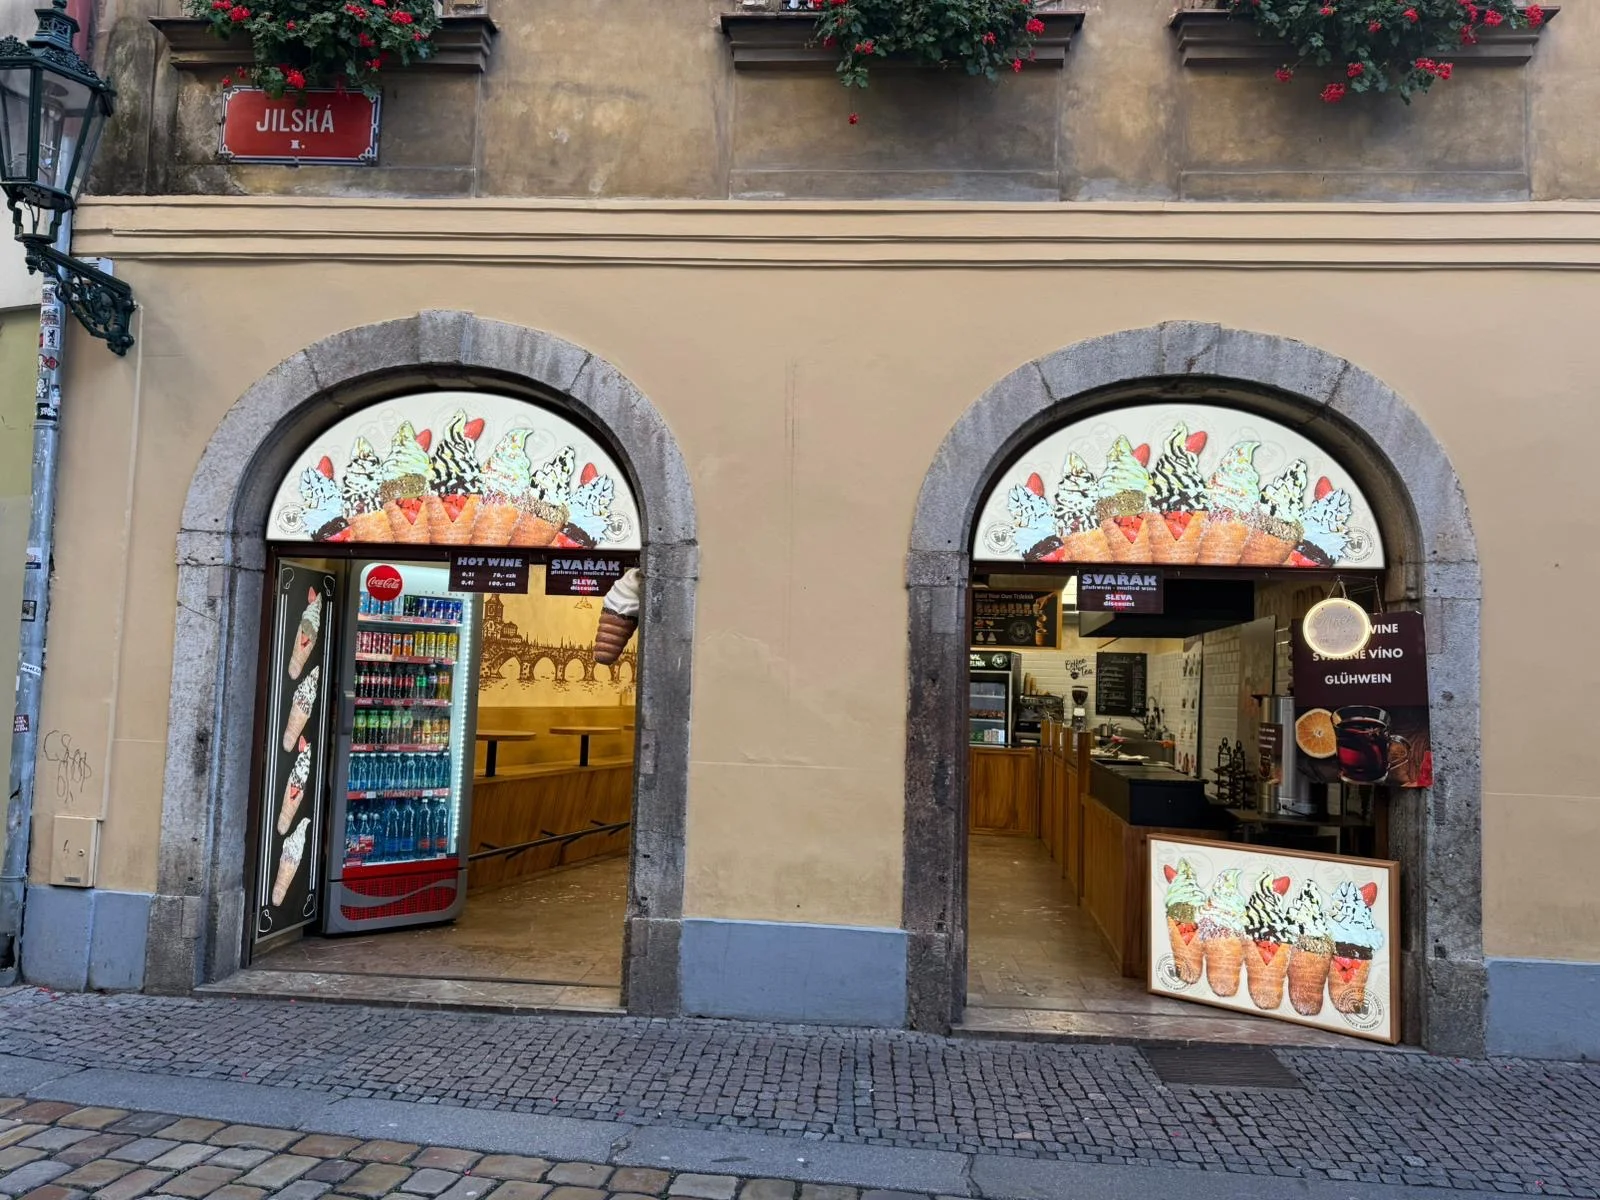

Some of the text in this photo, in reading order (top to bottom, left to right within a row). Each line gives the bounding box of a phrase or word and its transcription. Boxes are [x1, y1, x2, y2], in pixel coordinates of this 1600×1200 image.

[256, 104, 335, 133] JILSKÁ
[457, 556, 523, 568] HOT WINE
[551, 558, 620, 571] SVAŘÁK
[572, 578, 598, 586] SLEVA
[1081, 572, 1157, 586] SVAŘÁK
[1105, 593, 1133, 601] SLEVA
[1369, 645, 1404, 659] VÍNO
[1324, 672, 1392, 685] GLÜHWEIN
